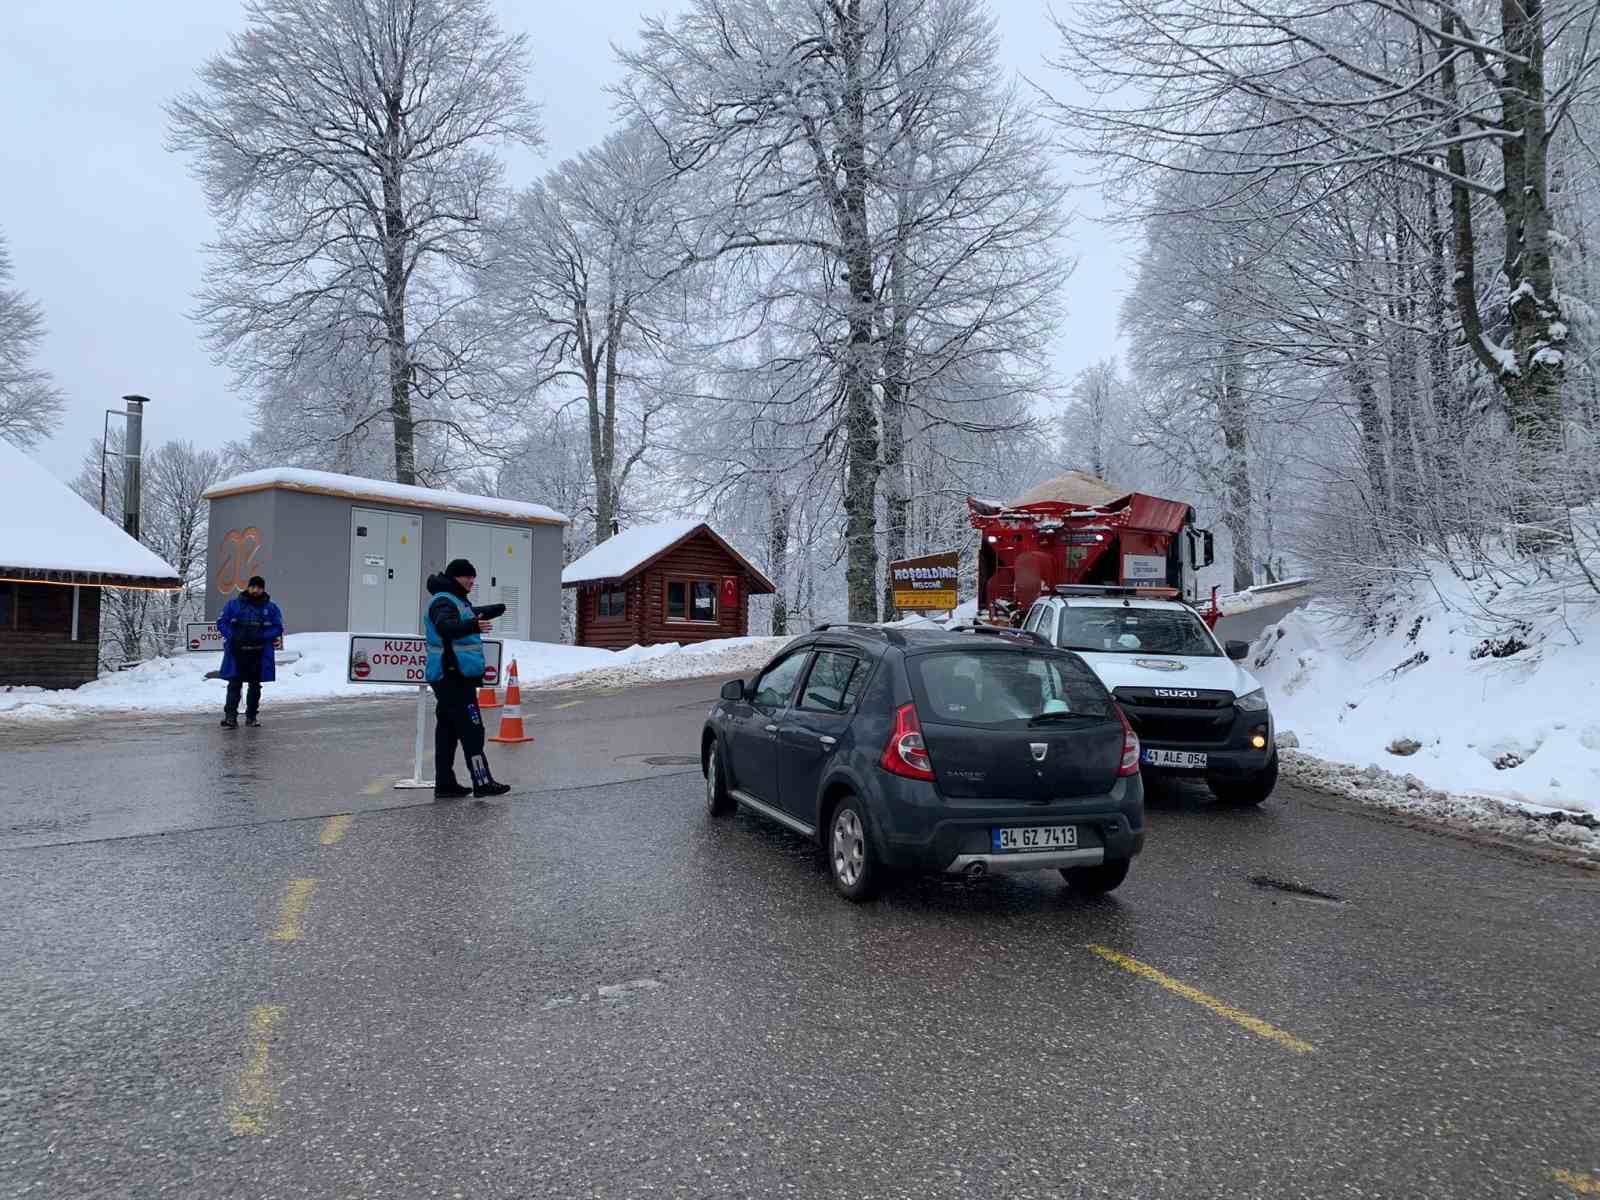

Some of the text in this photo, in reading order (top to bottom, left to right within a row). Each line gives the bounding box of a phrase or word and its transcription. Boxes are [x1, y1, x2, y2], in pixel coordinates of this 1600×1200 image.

[384, 640, 427, 652] KUZU
[372, 654, 427, 666] OTOPAR
[406, 669, 425, 680] DO
[1154, 689, 1198, 698] ISUZU
[1148, 749, 1207, 765] 41 ALE 054
[1001, 828, 1075, 847] 34 GZ 7413
